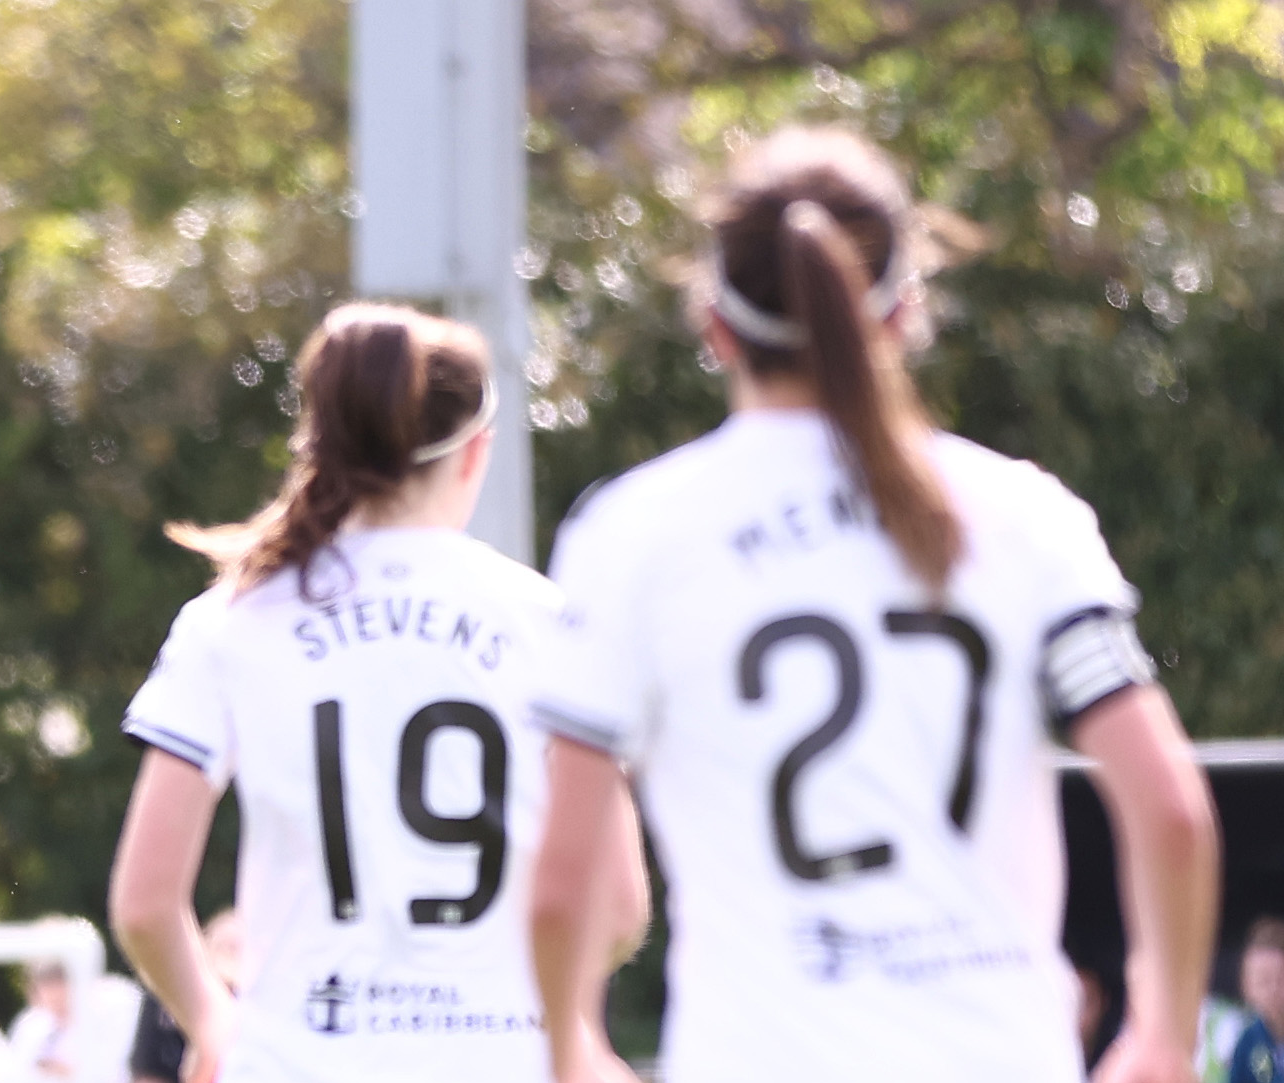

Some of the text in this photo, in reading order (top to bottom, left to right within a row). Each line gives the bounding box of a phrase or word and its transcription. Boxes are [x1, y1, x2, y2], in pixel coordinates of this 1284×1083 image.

[294, 597, 512, 671] STEVENS
[739, 611, 989, 880] 27
[314, 698, 508, 926] 19
